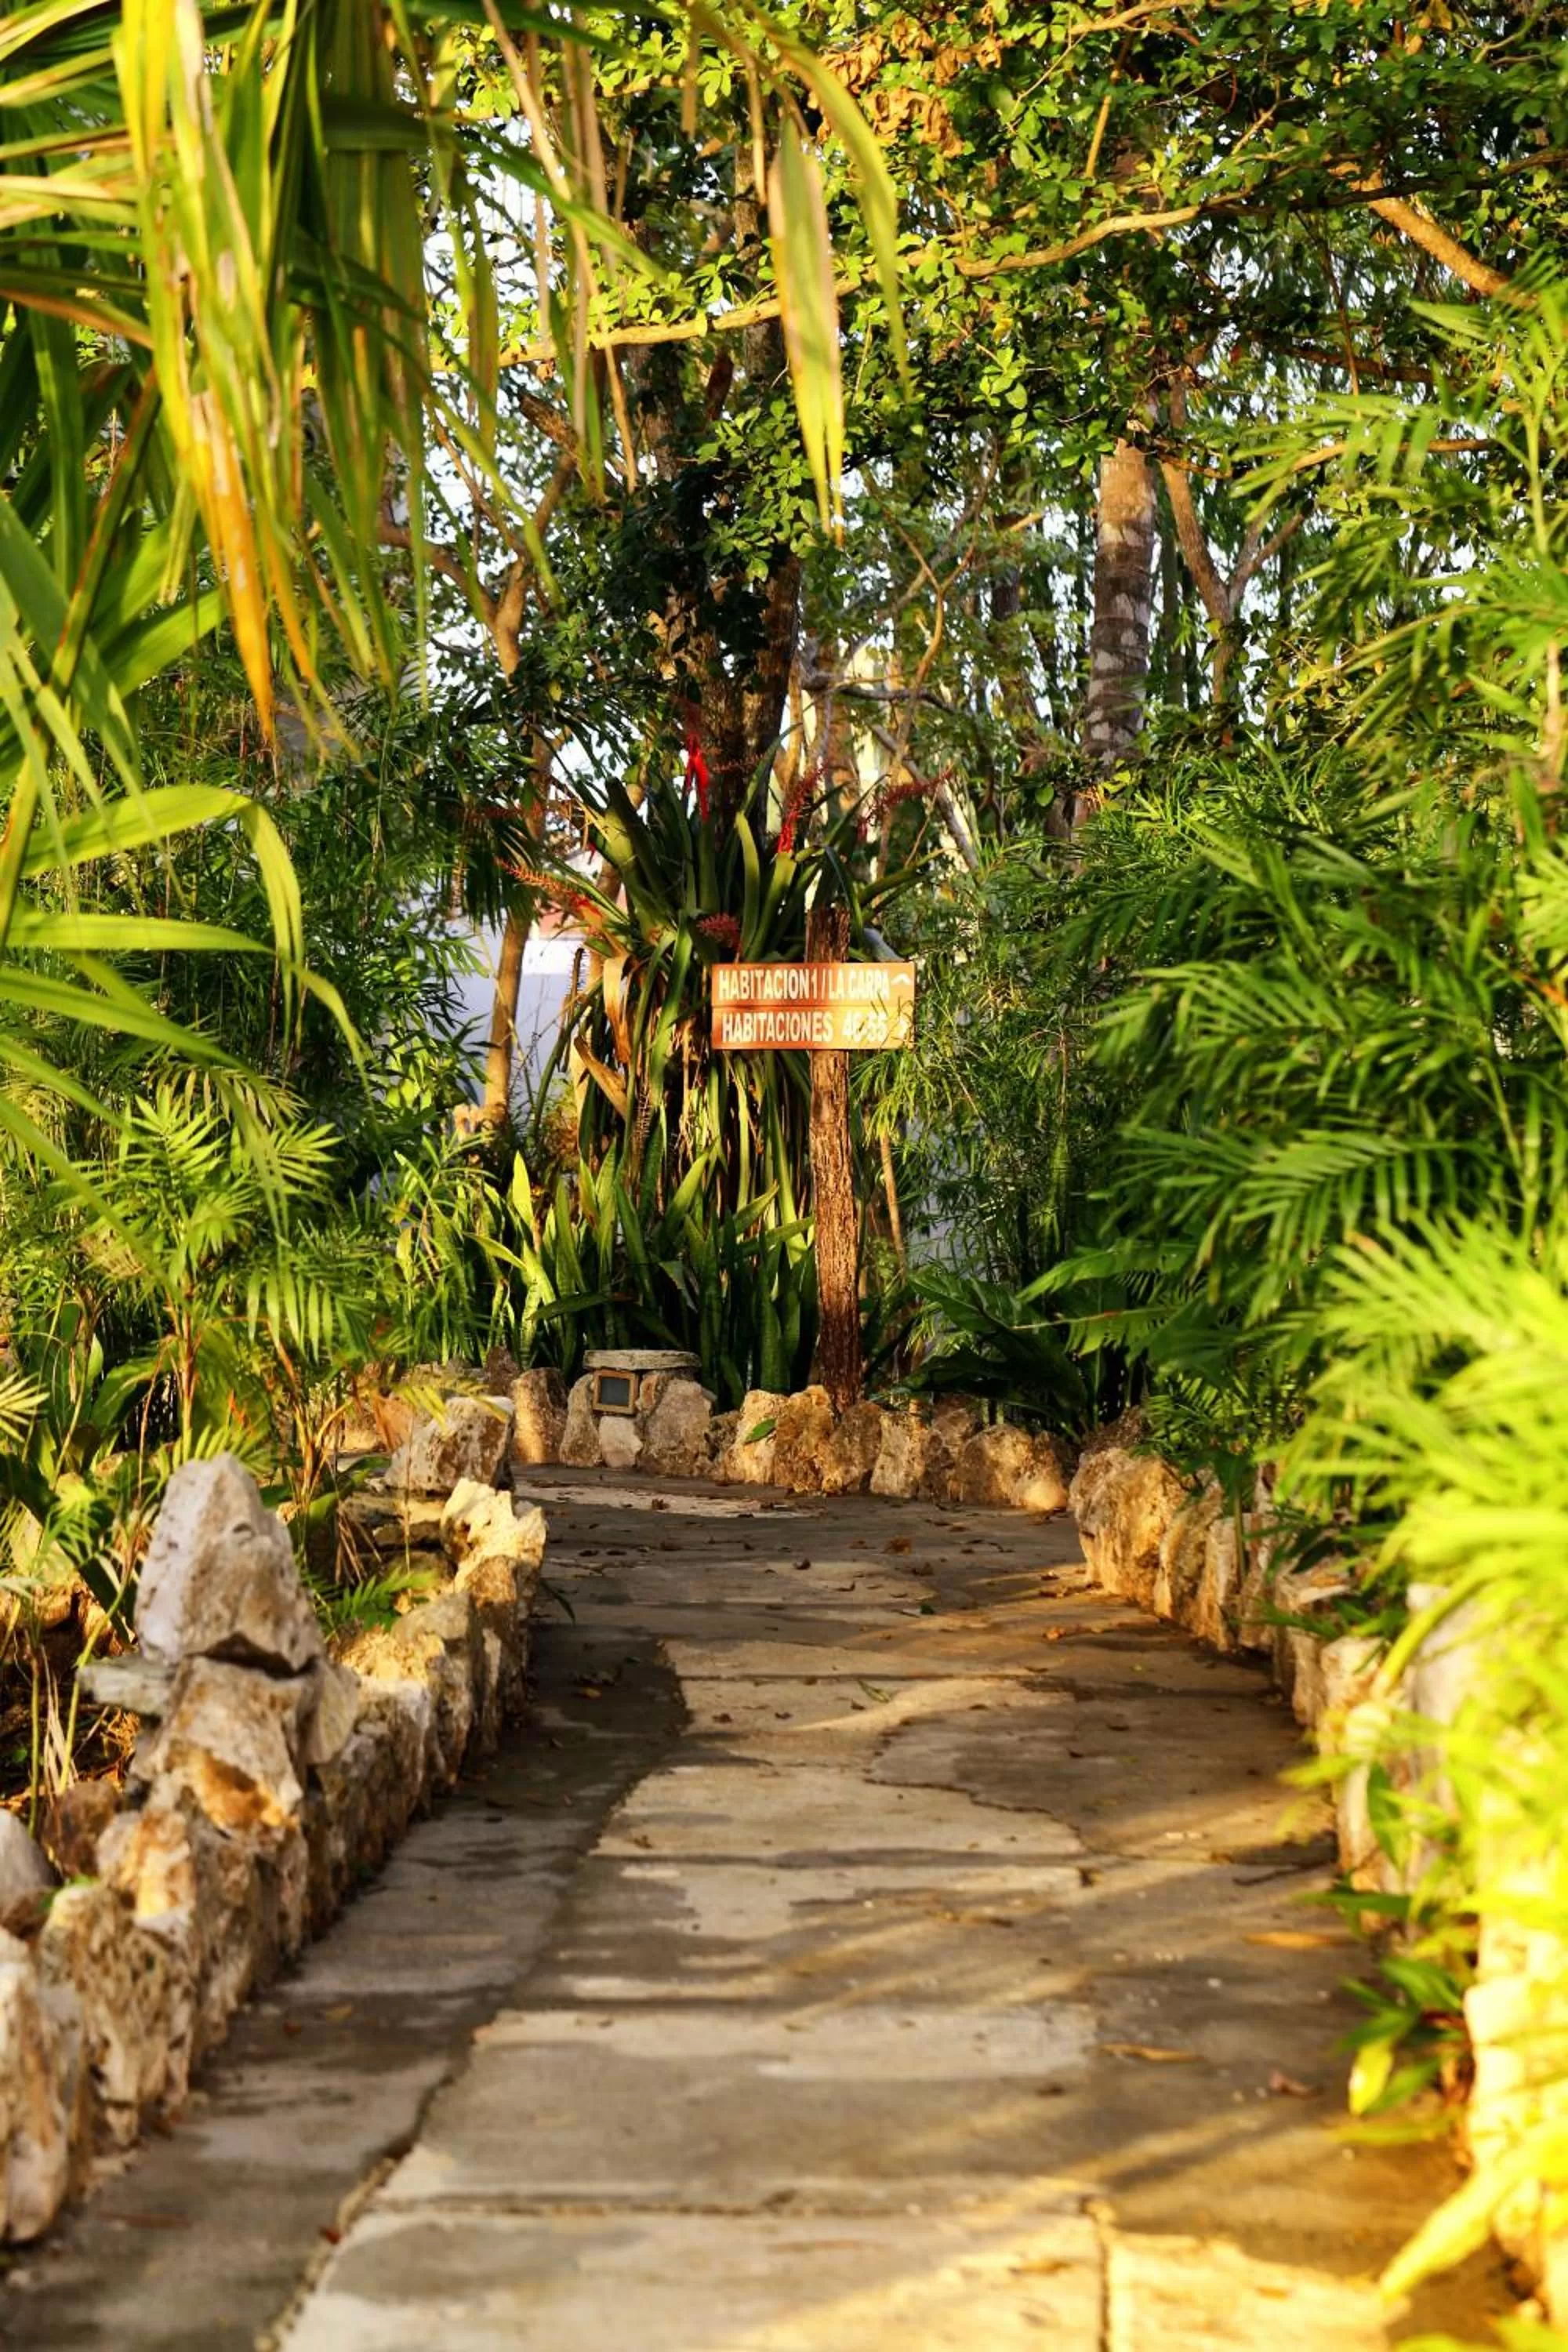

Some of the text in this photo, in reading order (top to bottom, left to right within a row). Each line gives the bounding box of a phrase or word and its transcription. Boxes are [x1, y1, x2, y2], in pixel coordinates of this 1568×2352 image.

[719, 968, 809, 1000] HABITACION
[828, 968, 845, 1000] LA
[848, 968, 890, 1000] CARPA
[722, 1011, 833, 1042] HABITACIONES
